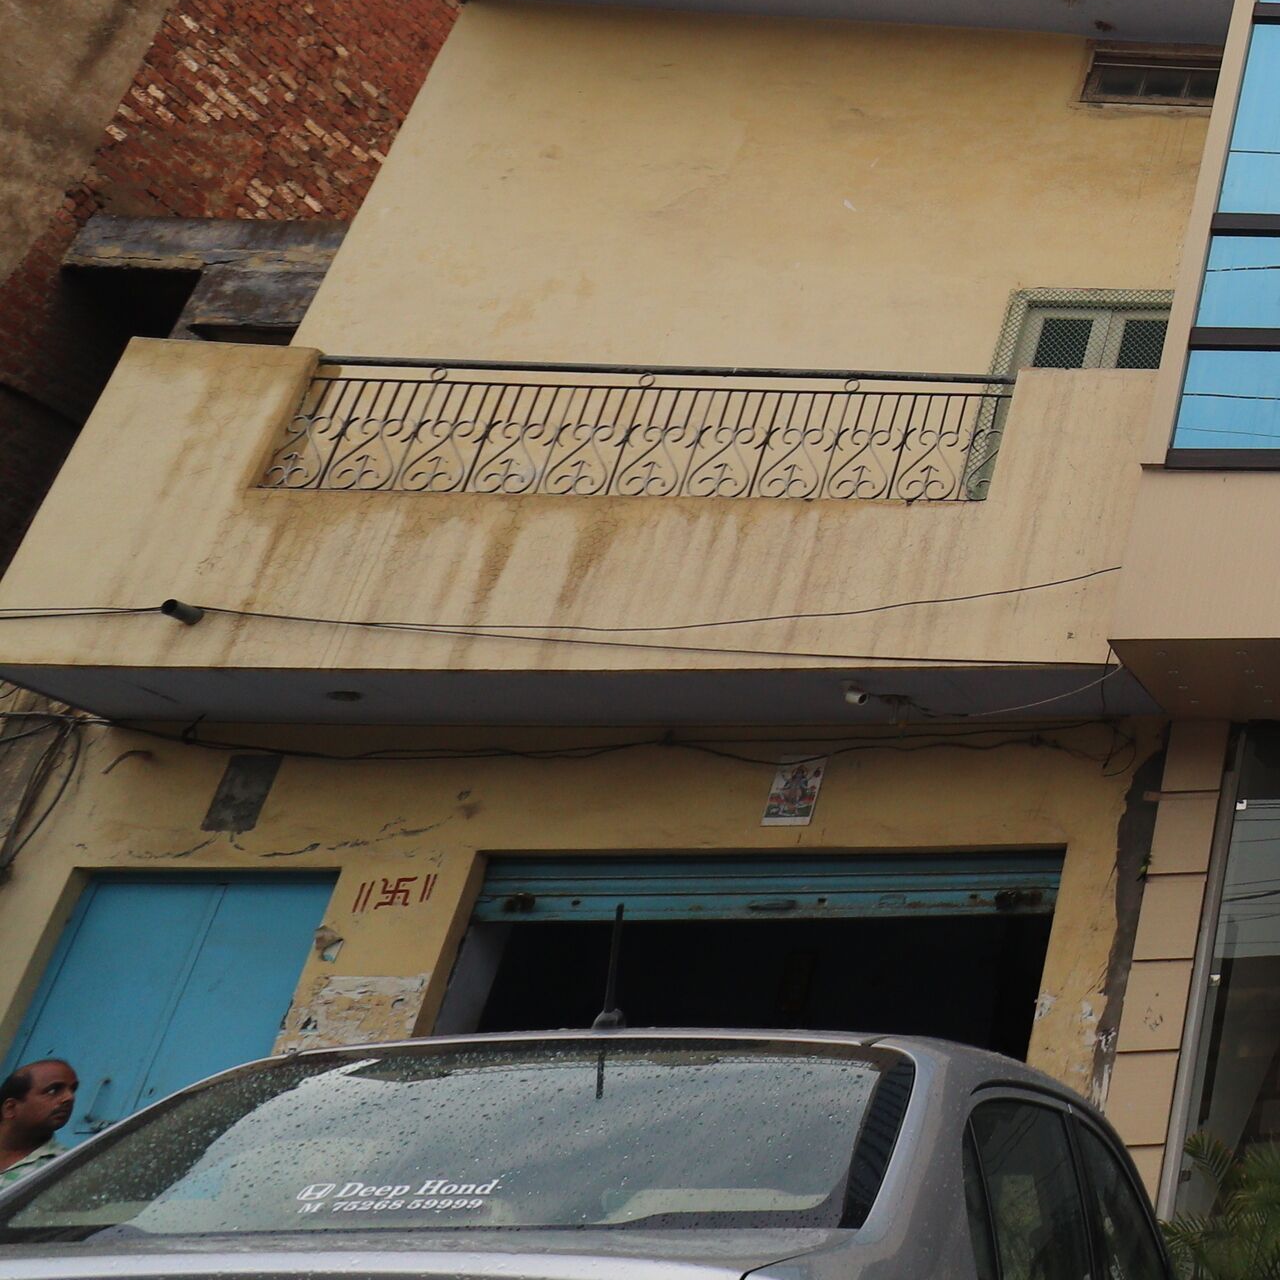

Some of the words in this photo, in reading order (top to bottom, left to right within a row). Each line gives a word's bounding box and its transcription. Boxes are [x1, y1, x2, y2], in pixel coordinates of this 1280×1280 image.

[334, 1183, 410, 1199] Deep
[298, 1202, 323, 1213] M
[332, 1200, 404, 1212] 75268
[407, 1199, 483, 1210] 59999
